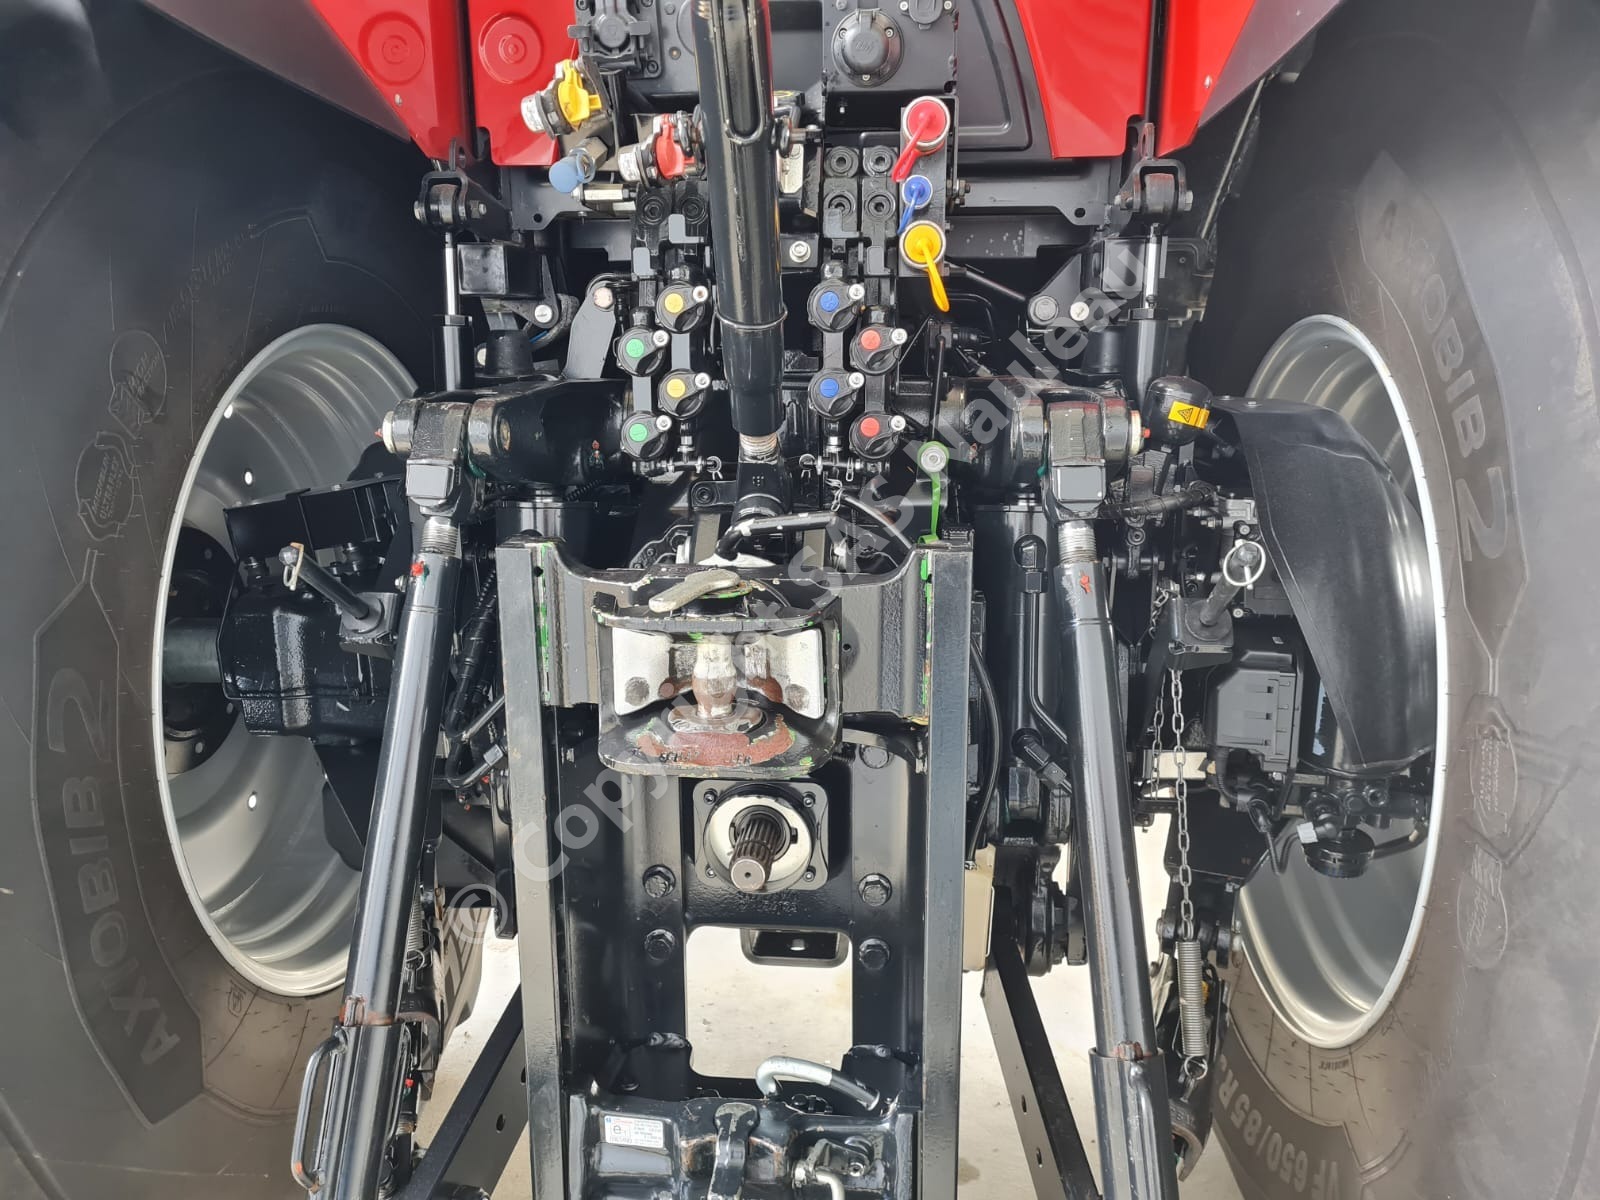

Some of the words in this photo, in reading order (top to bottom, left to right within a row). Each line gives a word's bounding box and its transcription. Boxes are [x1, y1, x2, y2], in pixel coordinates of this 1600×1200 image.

[1455, 466, 1508, 562] 2
[46, 666, 116, 762] 2
[62, 775, 181, 1065] AXIOBIB
[1230, 1093, 1308, 1193] 650/85
